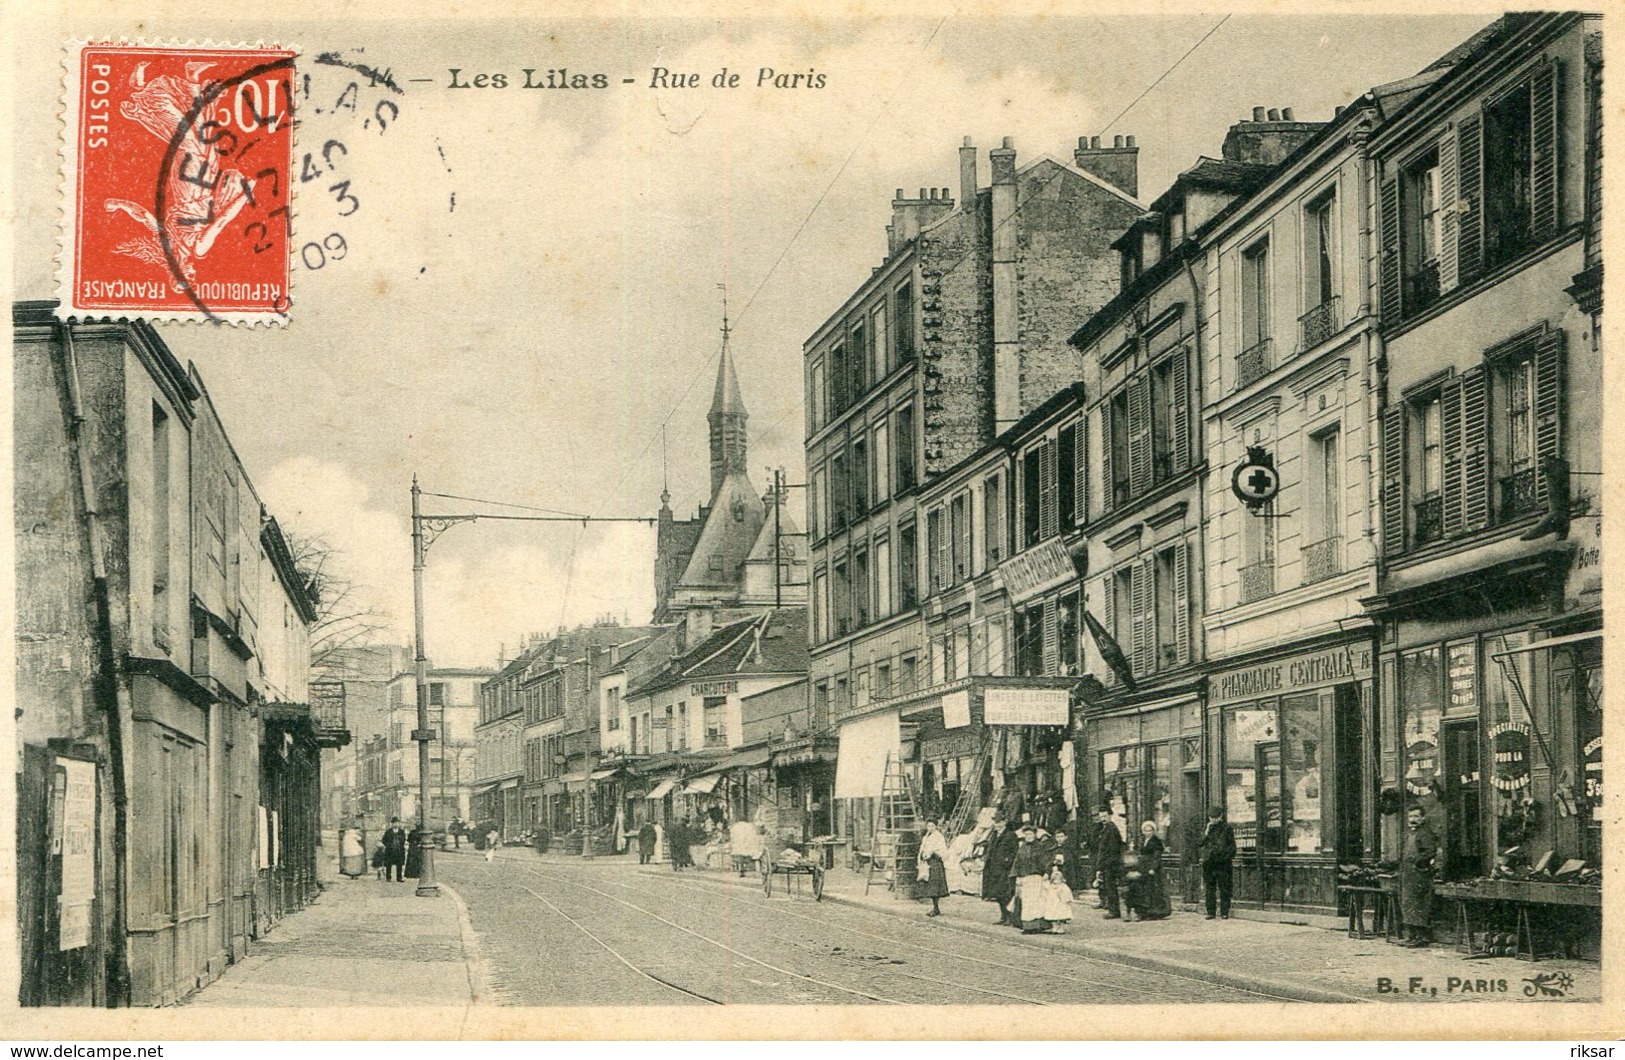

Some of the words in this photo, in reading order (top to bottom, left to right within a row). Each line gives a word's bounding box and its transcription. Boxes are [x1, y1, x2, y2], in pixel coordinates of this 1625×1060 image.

[88, 63, 111, 150] POSTES
[301, 232, 348, 271] 09
[82, 279, 167, 301] FRANÇAISE
[690, 680, 739, 697] CHARCUTERIE
[1221, 665, 1283, 699] PHARMACIE
[1289, 650, 1354, 686] CENTRALE
[1513, 751, 1523, 761] LA
